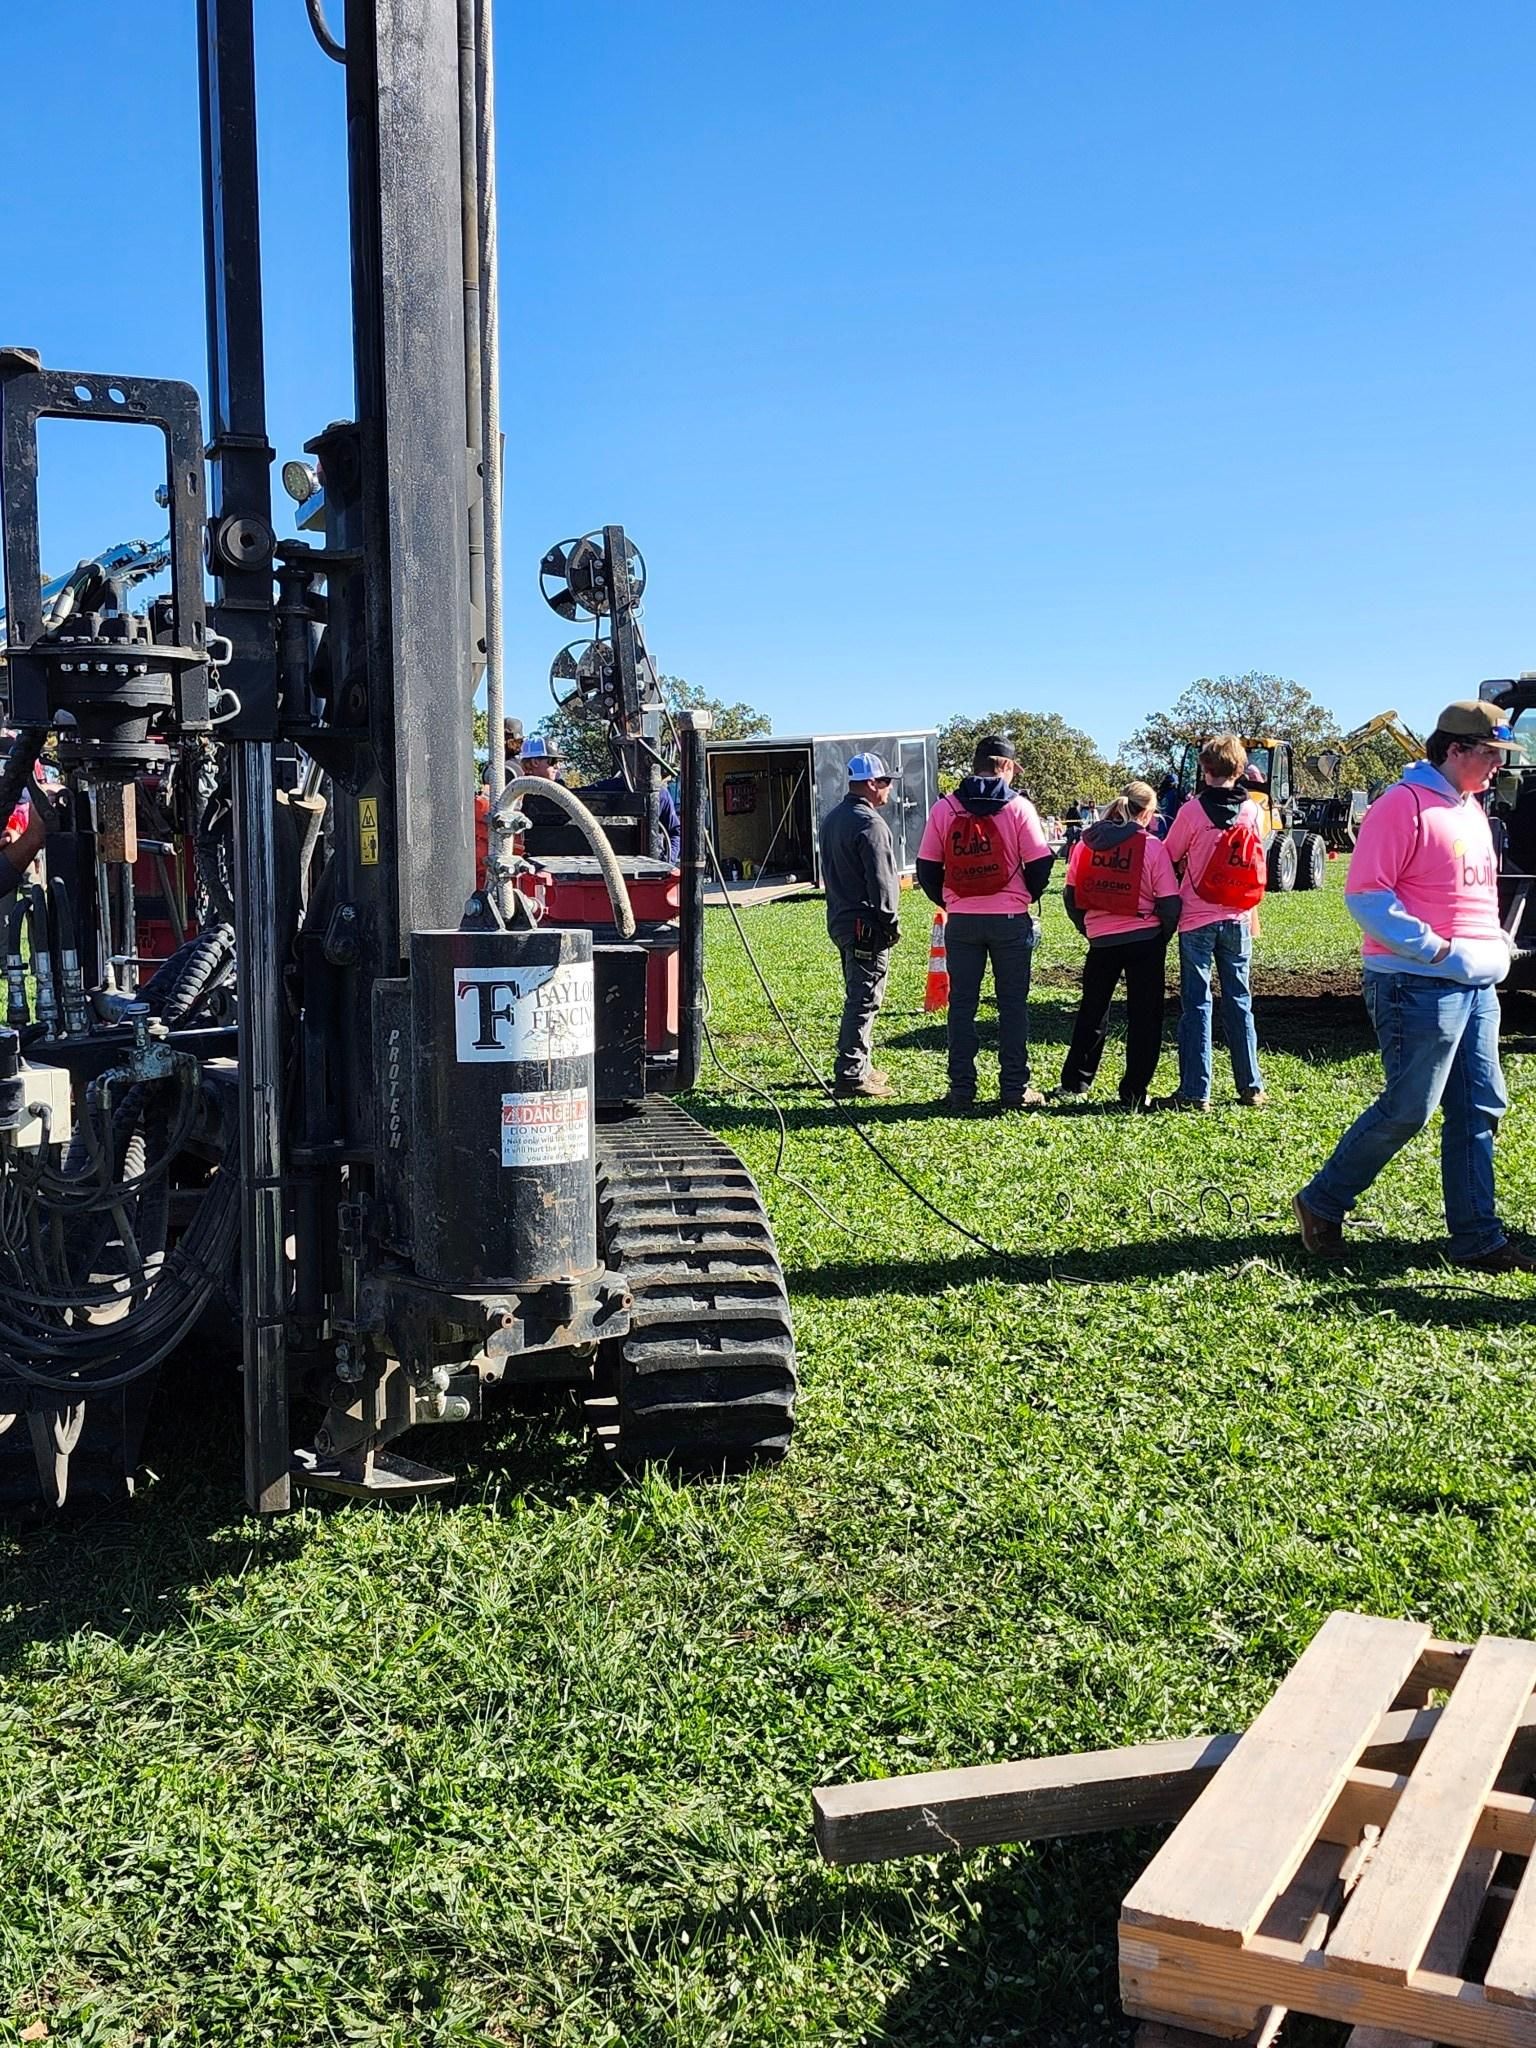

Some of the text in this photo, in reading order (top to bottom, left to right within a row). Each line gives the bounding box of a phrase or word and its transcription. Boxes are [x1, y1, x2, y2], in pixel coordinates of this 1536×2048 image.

[953, 832, 992, 857] build
[1092, 846, 1133, 870] build
[1462, 846, 1495, 887] buil
[388, 1029, 401, 1149] PROTECH
[522, 1103, 577, 1124] DANGER
[510, 1126, 528, 1136] DO
[531, 1125, 552, 1135] NOT
